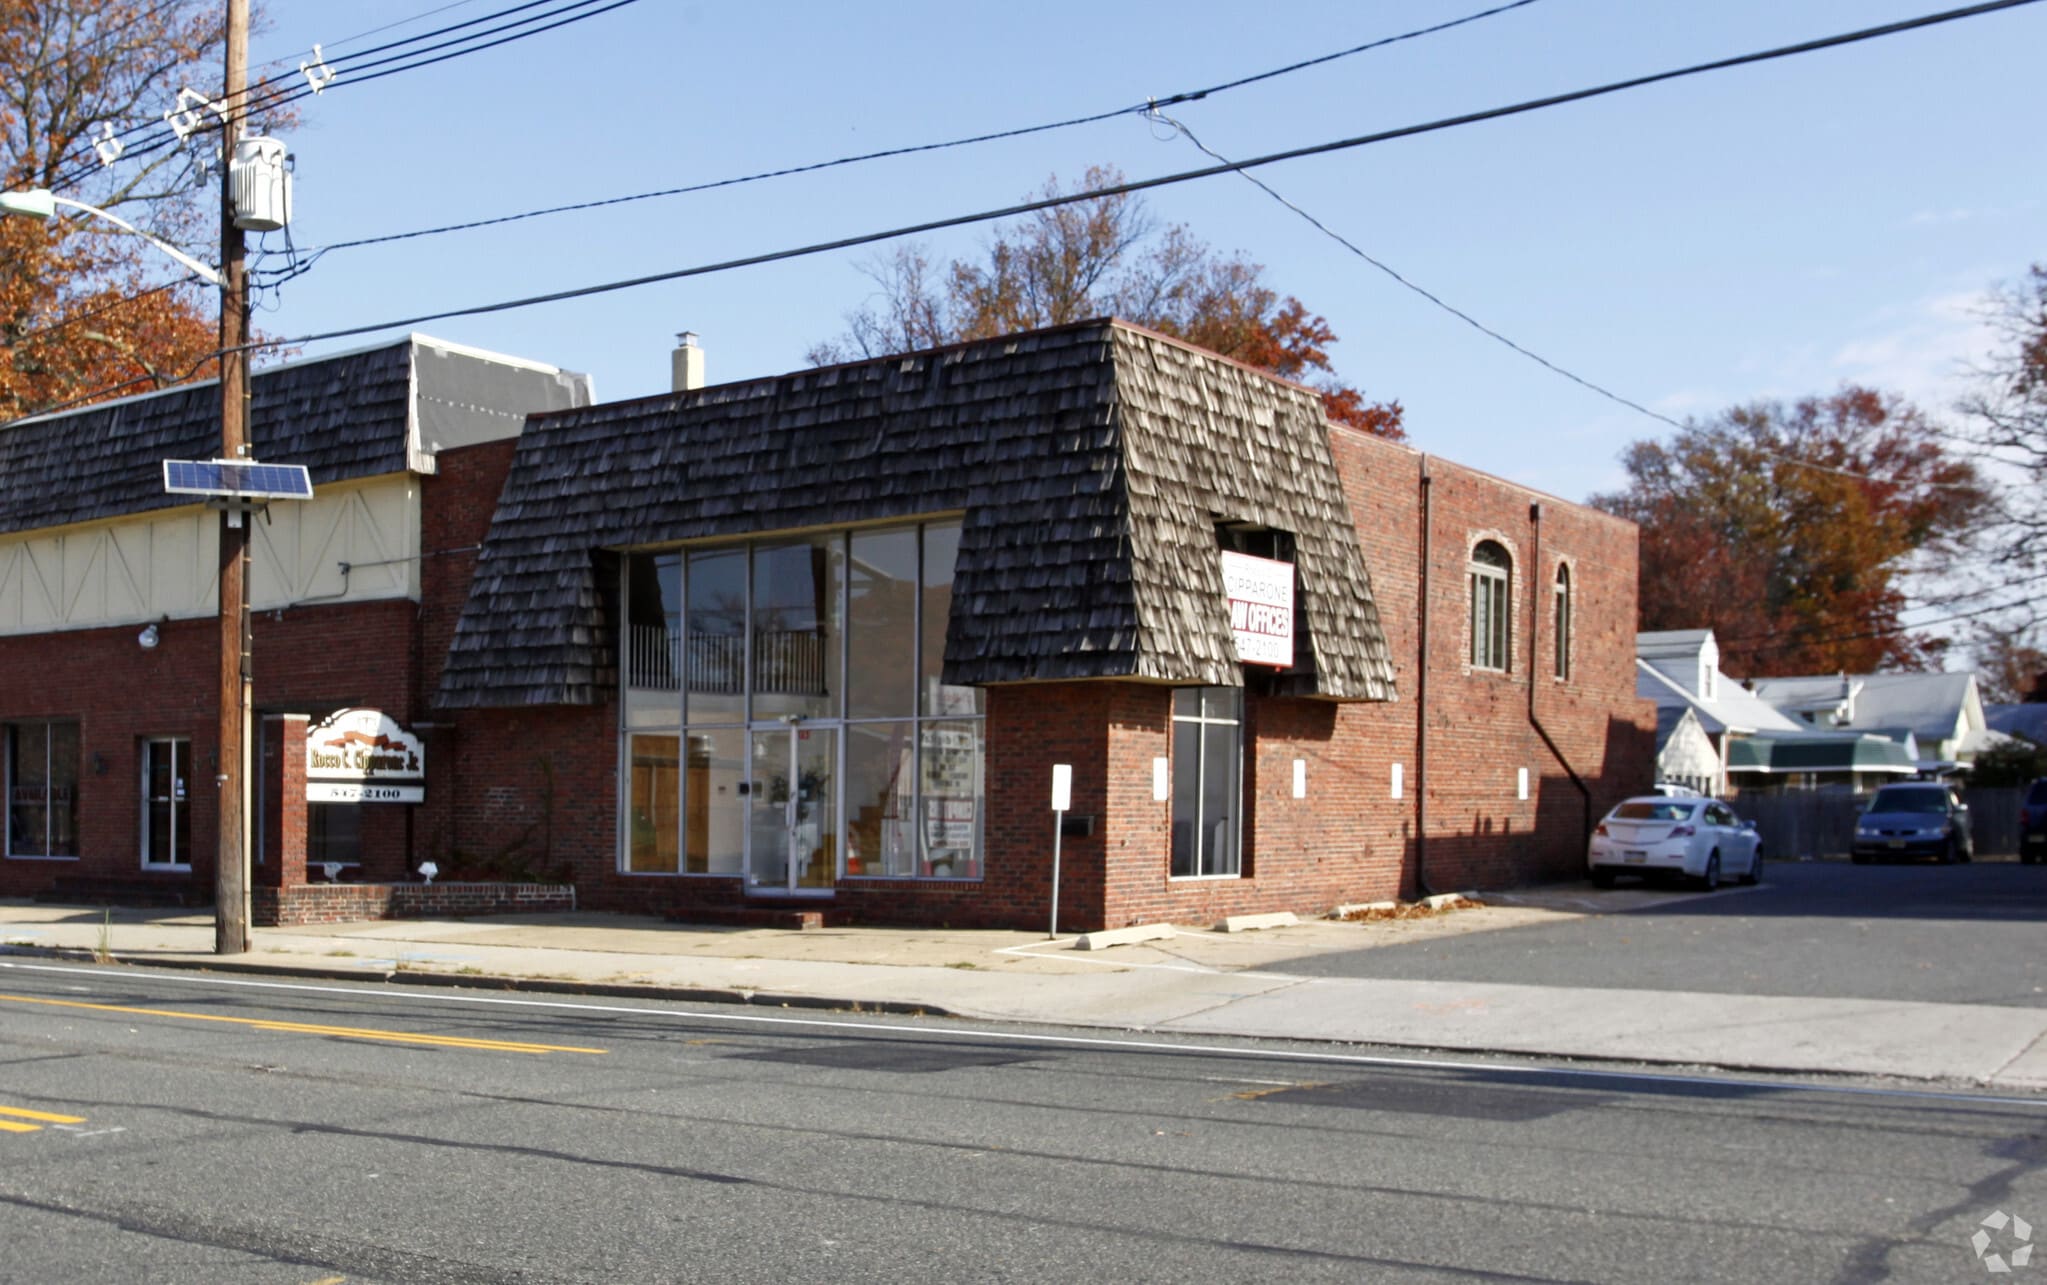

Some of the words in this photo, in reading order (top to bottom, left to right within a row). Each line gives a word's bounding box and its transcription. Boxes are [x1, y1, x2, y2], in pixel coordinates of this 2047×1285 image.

[1227, 576, 1288, 602] CIPPARONE
[1230, 600, 1248, 631] AW
[1248, 603, 1289, 636] OFFICES
[311, 750, 341, 768] Rocco
